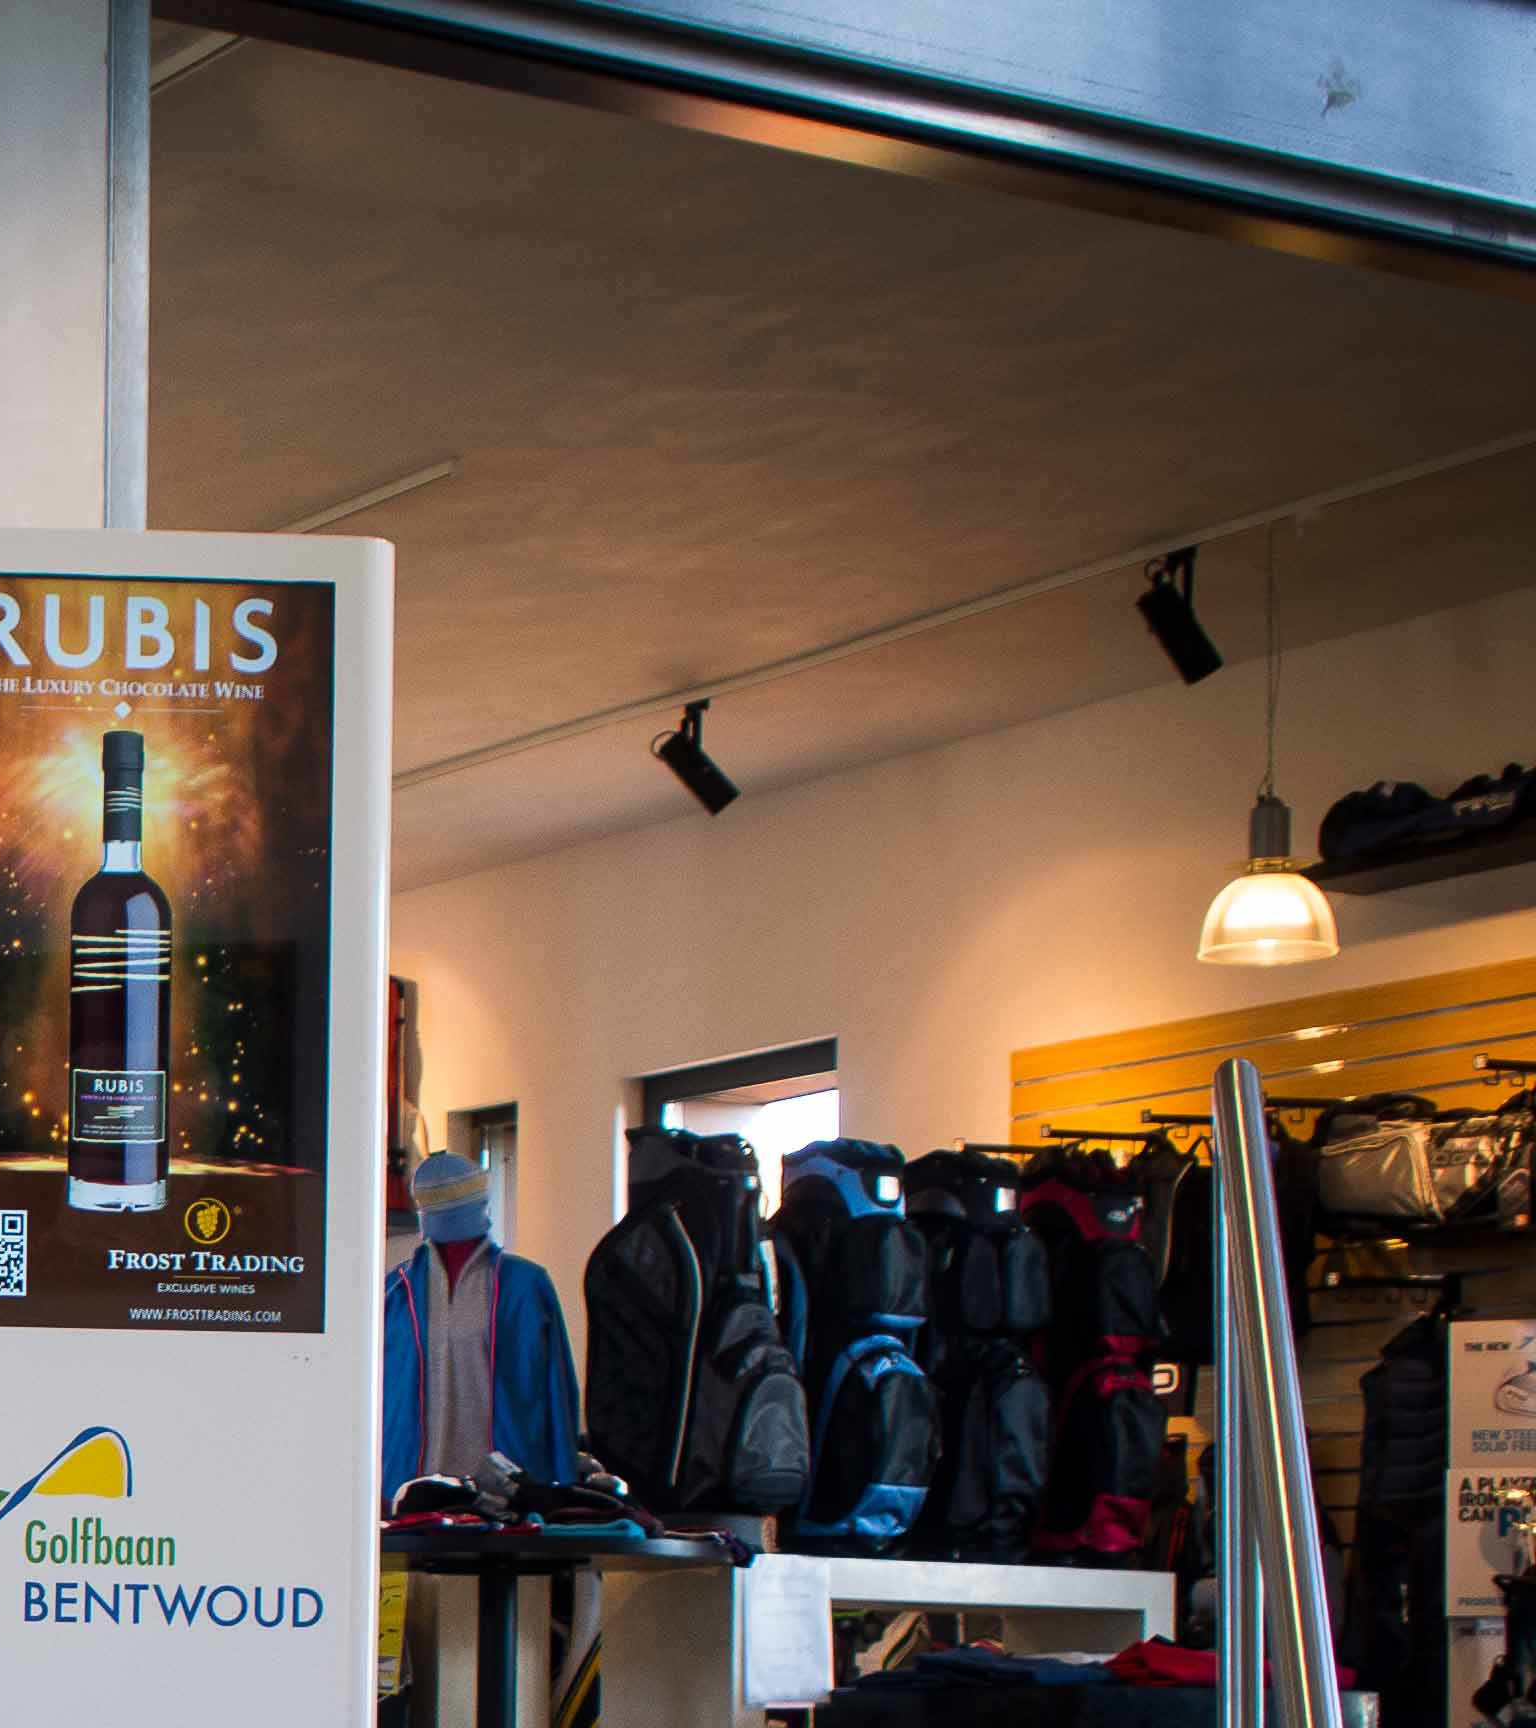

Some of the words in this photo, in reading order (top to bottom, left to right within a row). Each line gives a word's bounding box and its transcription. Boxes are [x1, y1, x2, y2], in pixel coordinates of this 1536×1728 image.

[23, 676, 96, 696] LUXURY
[99, 678, 210, 699] CHOCOLATE
[213, 681, 265, 699] WINE
[93, 1078, 145, 1094] RUBIS
[107, 1249, 186, 1271] FROST
[191, 1251, 305, 1274] TRADING
[156, 1282, 217, 1294] EXCLUSIVE
[219, 1284, 256, 1295] WINES
[129, 1308, 282, 1323] WWW.FROSTTRADING.COM
[24, 1516, 177, 1566] Golfbaan
[22, 1580, 325, 1628] BENTWOUD
